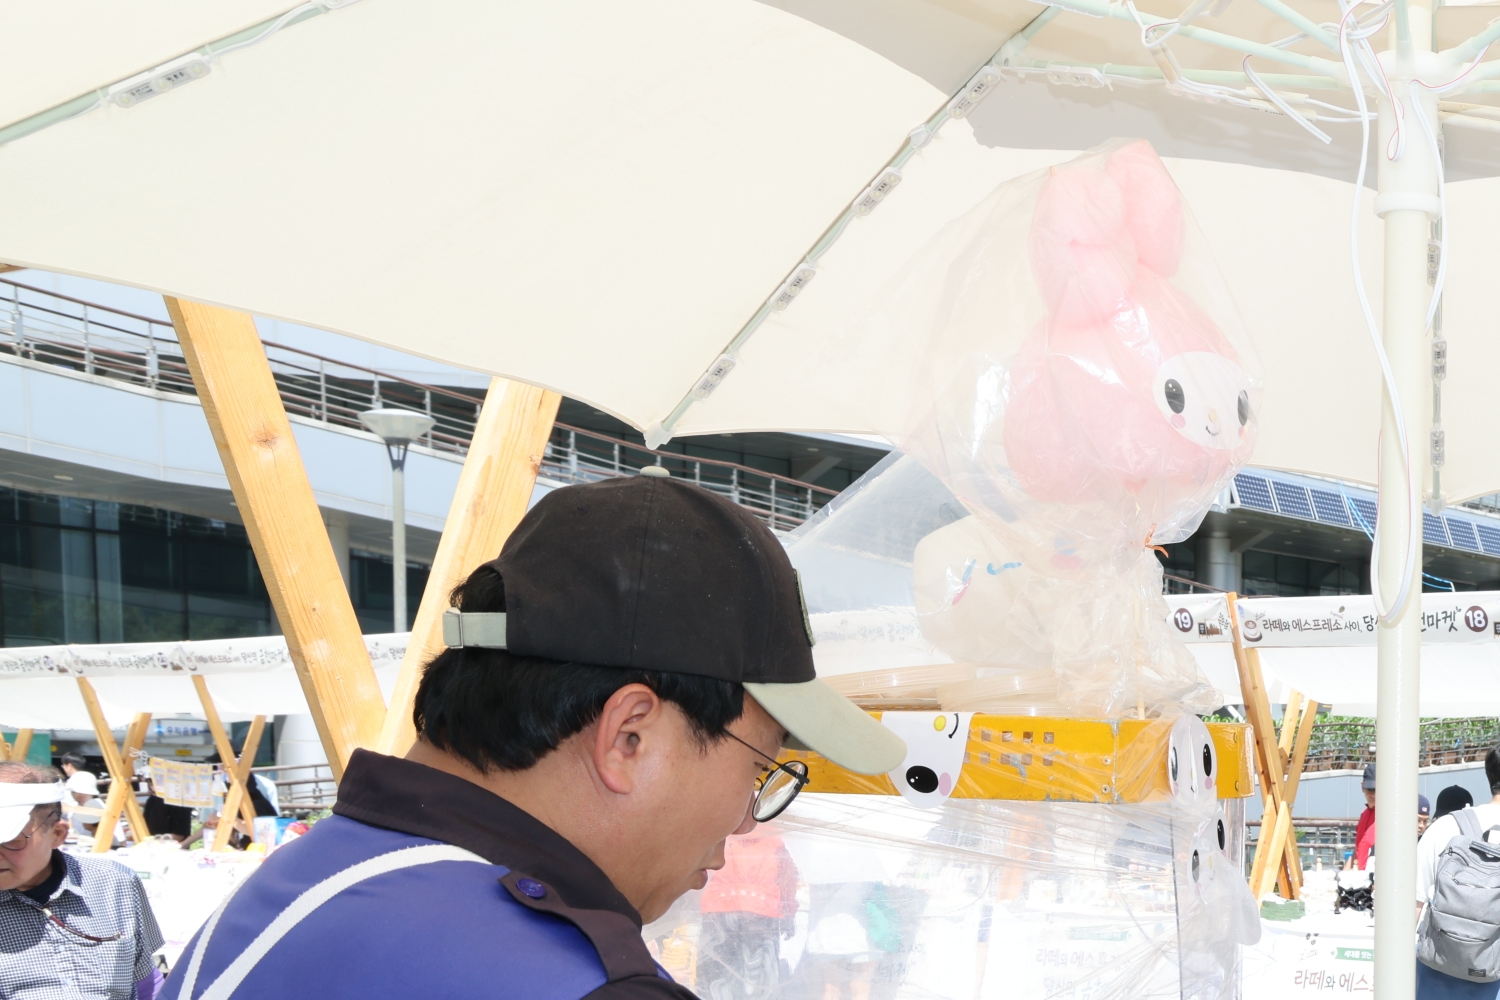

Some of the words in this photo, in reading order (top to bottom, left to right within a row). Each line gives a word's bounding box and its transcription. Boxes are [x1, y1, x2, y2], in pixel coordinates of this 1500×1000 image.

[1174, 612, 1193, 631] 19
[1262, 616, 1291, 635] 라떼와
[1292, 615, 1342, 634] 에스프레소
[1342, 619, 1363, 634] 사이,
[1466, 608, 1488, 629] 18
[1294, 968, 1336, 991] 라떼와
